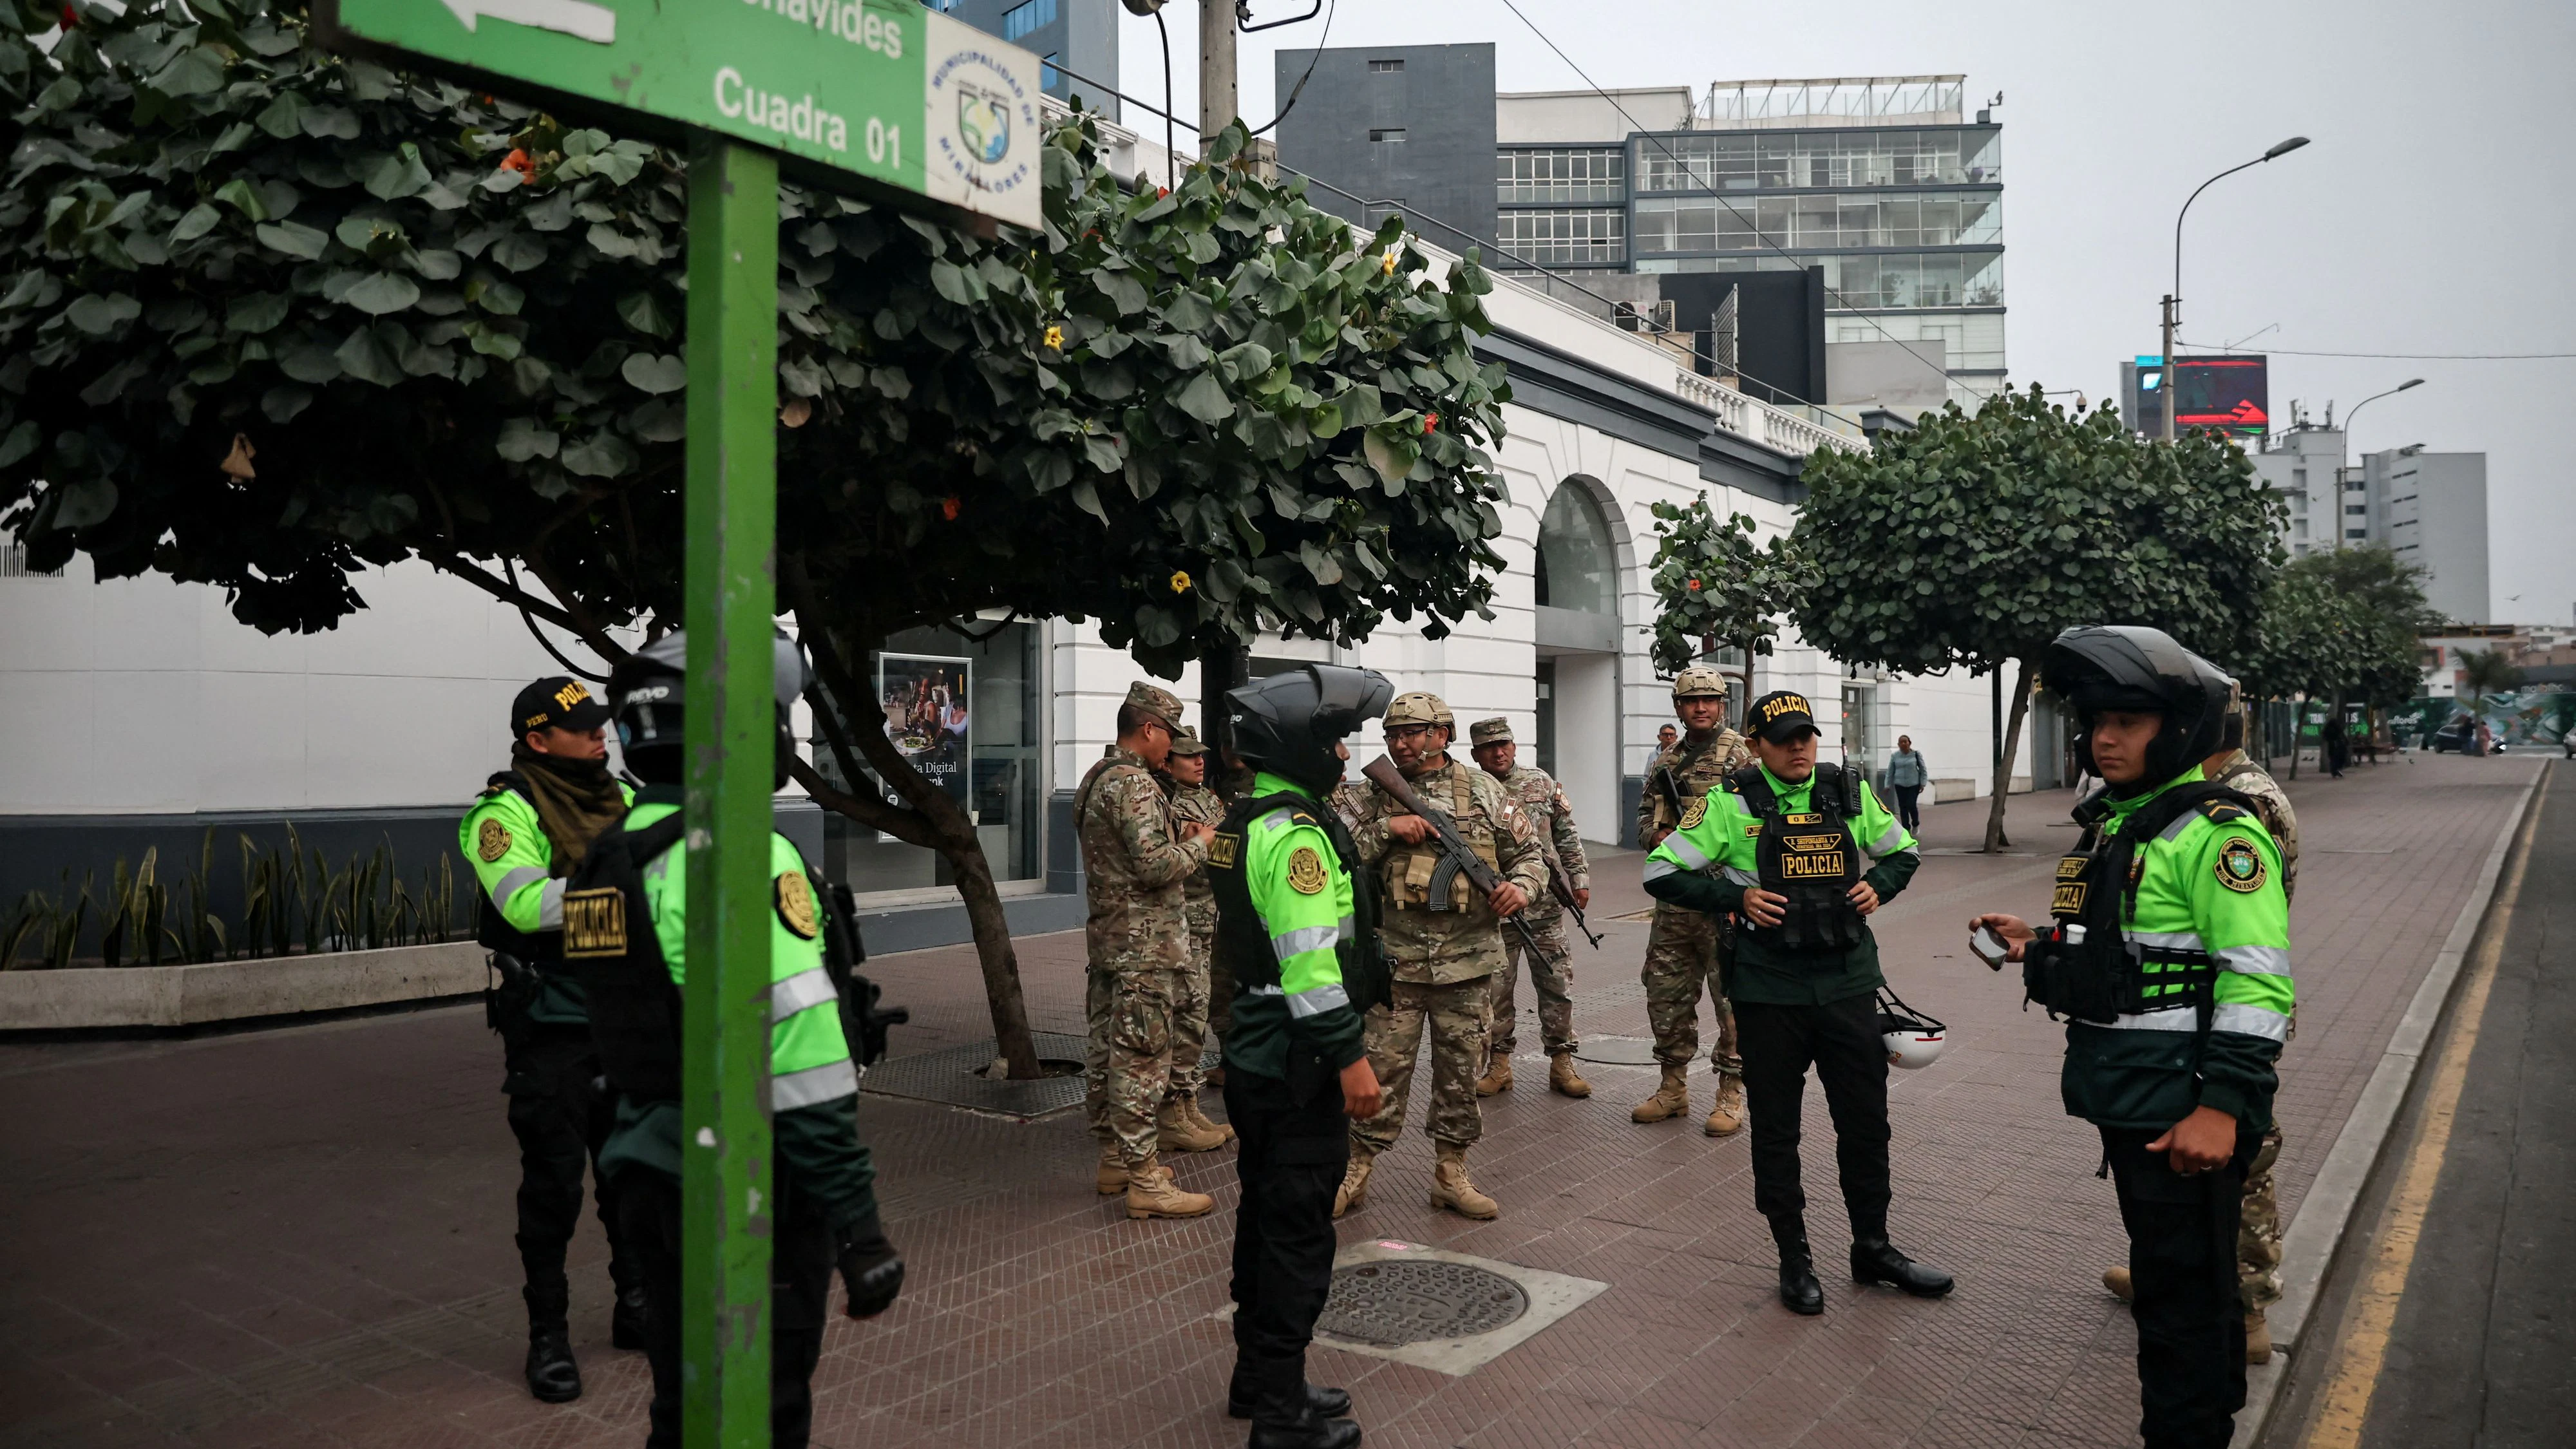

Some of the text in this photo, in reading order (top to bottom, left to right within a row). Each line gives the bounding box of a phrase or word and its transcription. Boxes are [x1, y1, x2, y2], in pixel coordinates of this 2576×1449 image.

[745, 0, 902, 59] avides
[714, 66, 902, 170] Cuadra 01
[1762, 696, 1810, 723] POLICIA
[526, 713, 548, 728] PERU
[925, 761, 957, 776] Digital
[1786, 855, 1841, 875] POLICIA
[2231, 871, 2264, 889] MIRAFLORES
